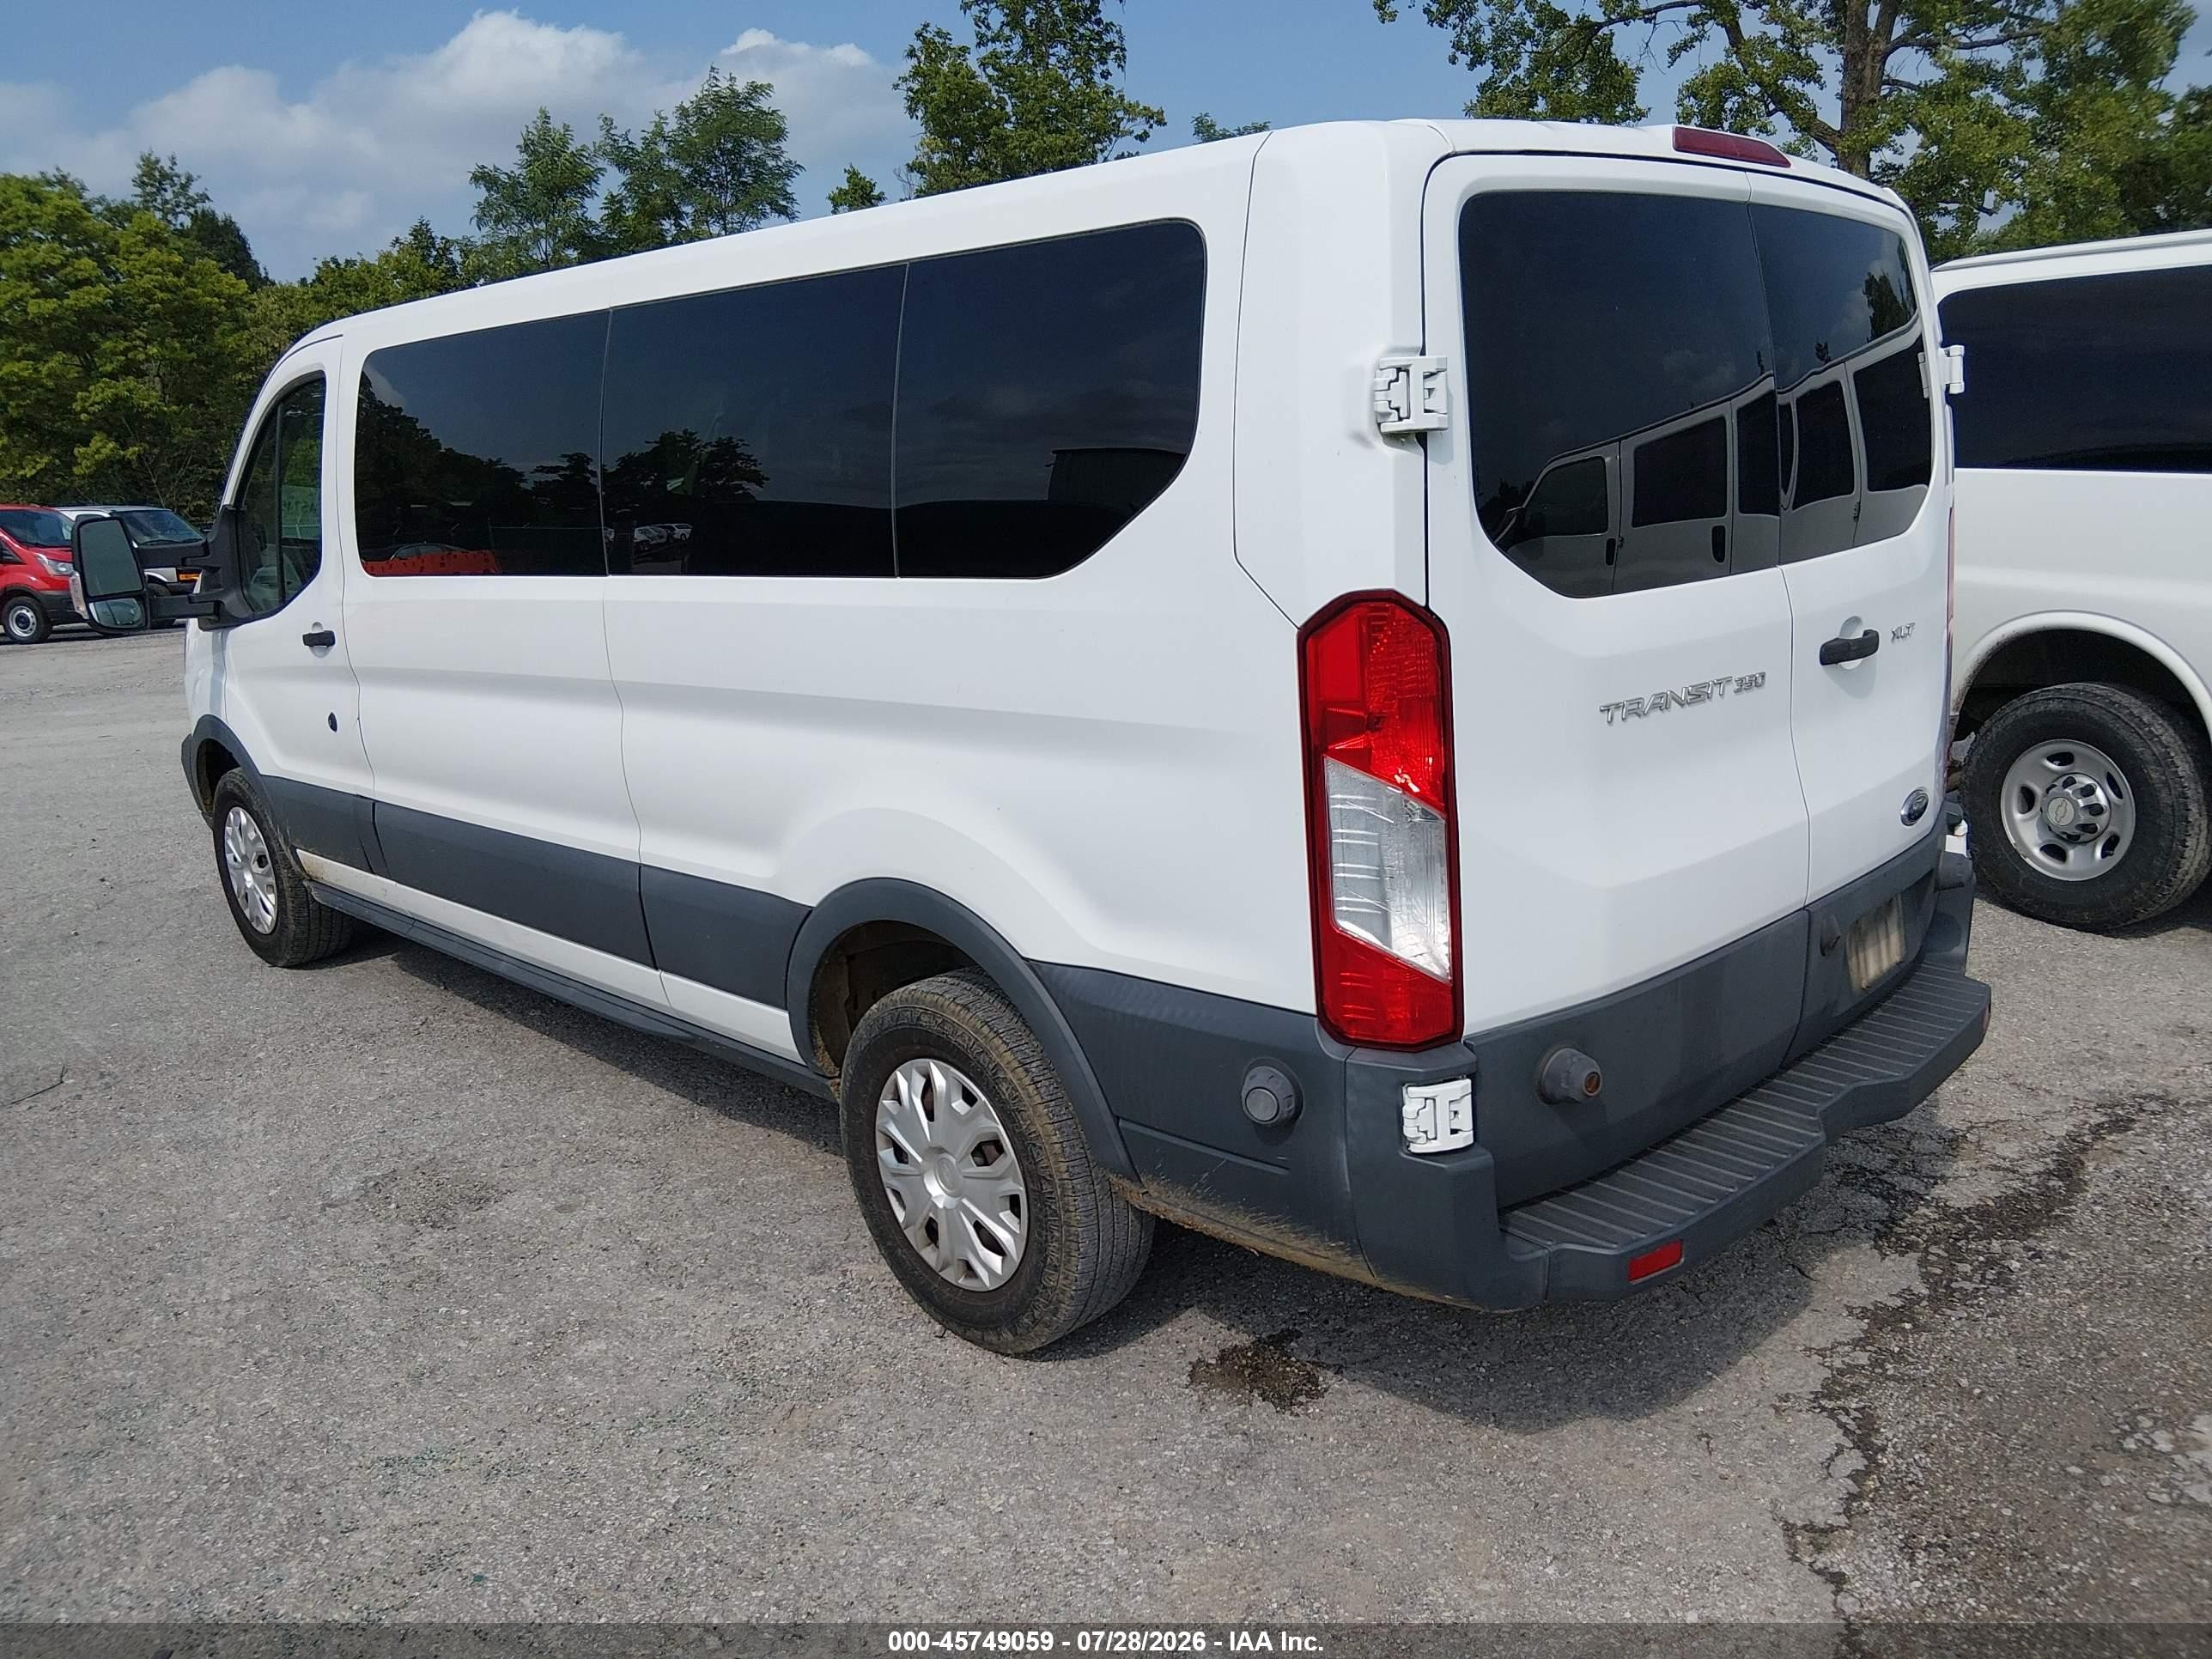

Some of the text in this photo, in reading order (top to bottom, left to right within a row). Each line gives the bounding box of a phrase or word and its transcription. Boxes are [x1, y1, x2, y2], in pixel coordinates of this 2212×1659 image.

[1891, 622, 1916, 642] XLT
[1600, 672, 1765, 723] TRANSIT 350
